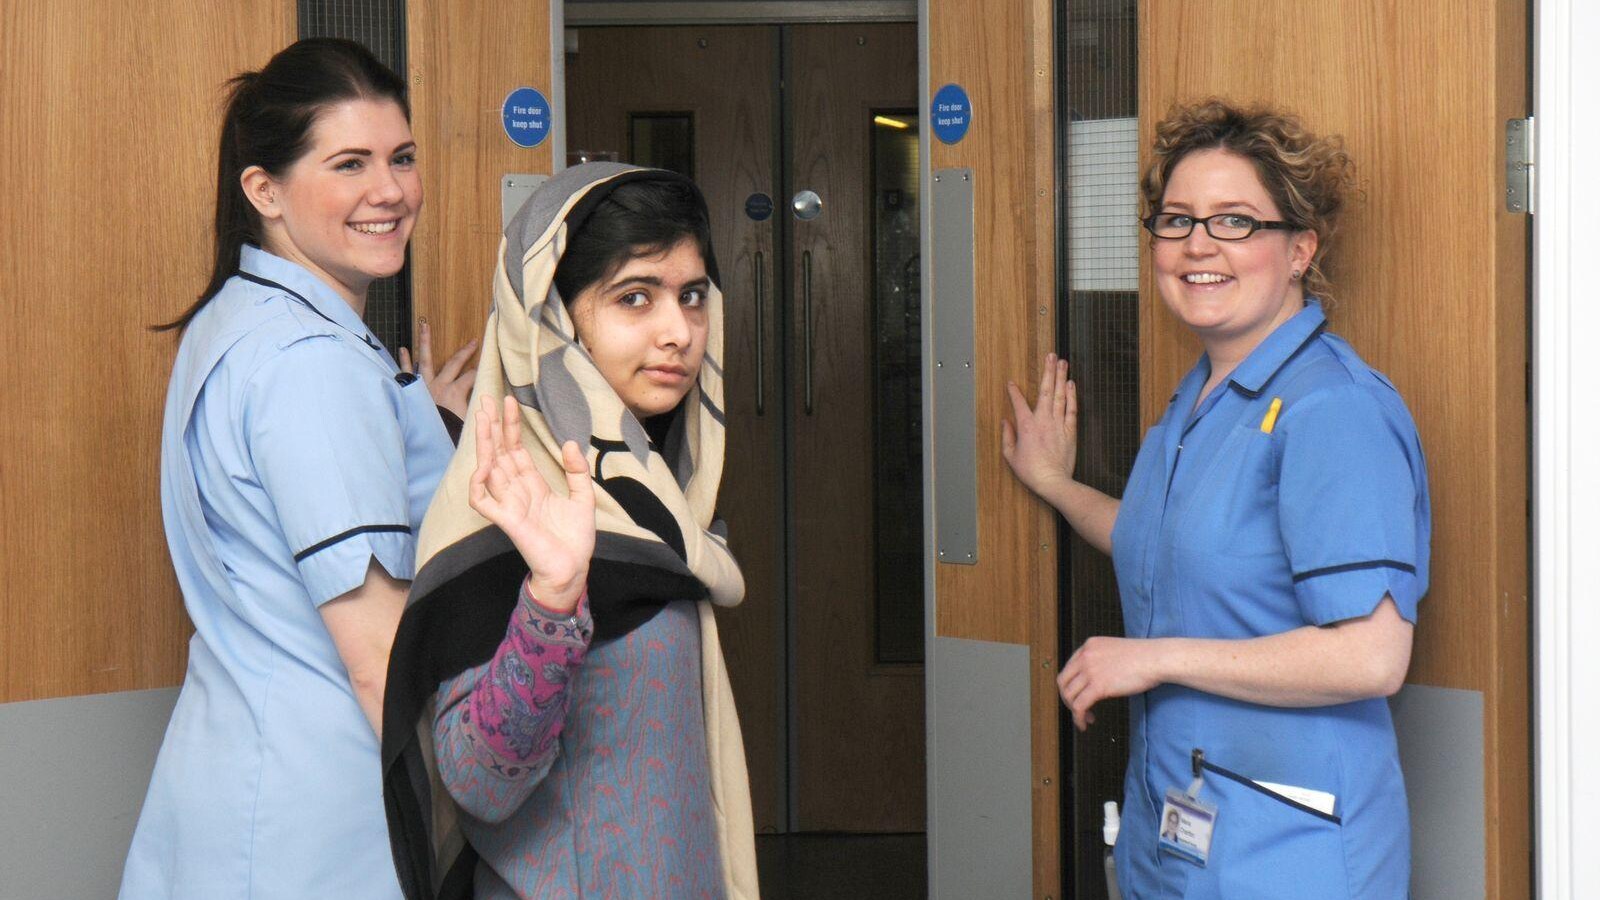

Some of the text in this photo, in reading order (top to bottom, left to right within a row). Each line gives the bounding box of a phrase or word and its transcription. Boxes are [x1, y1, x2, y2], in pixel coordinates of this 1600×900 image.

[513, 105, 542, 115] Fire door
[512, 120, 543, 130] keep shut
[938, 117, 951, 126] keep
